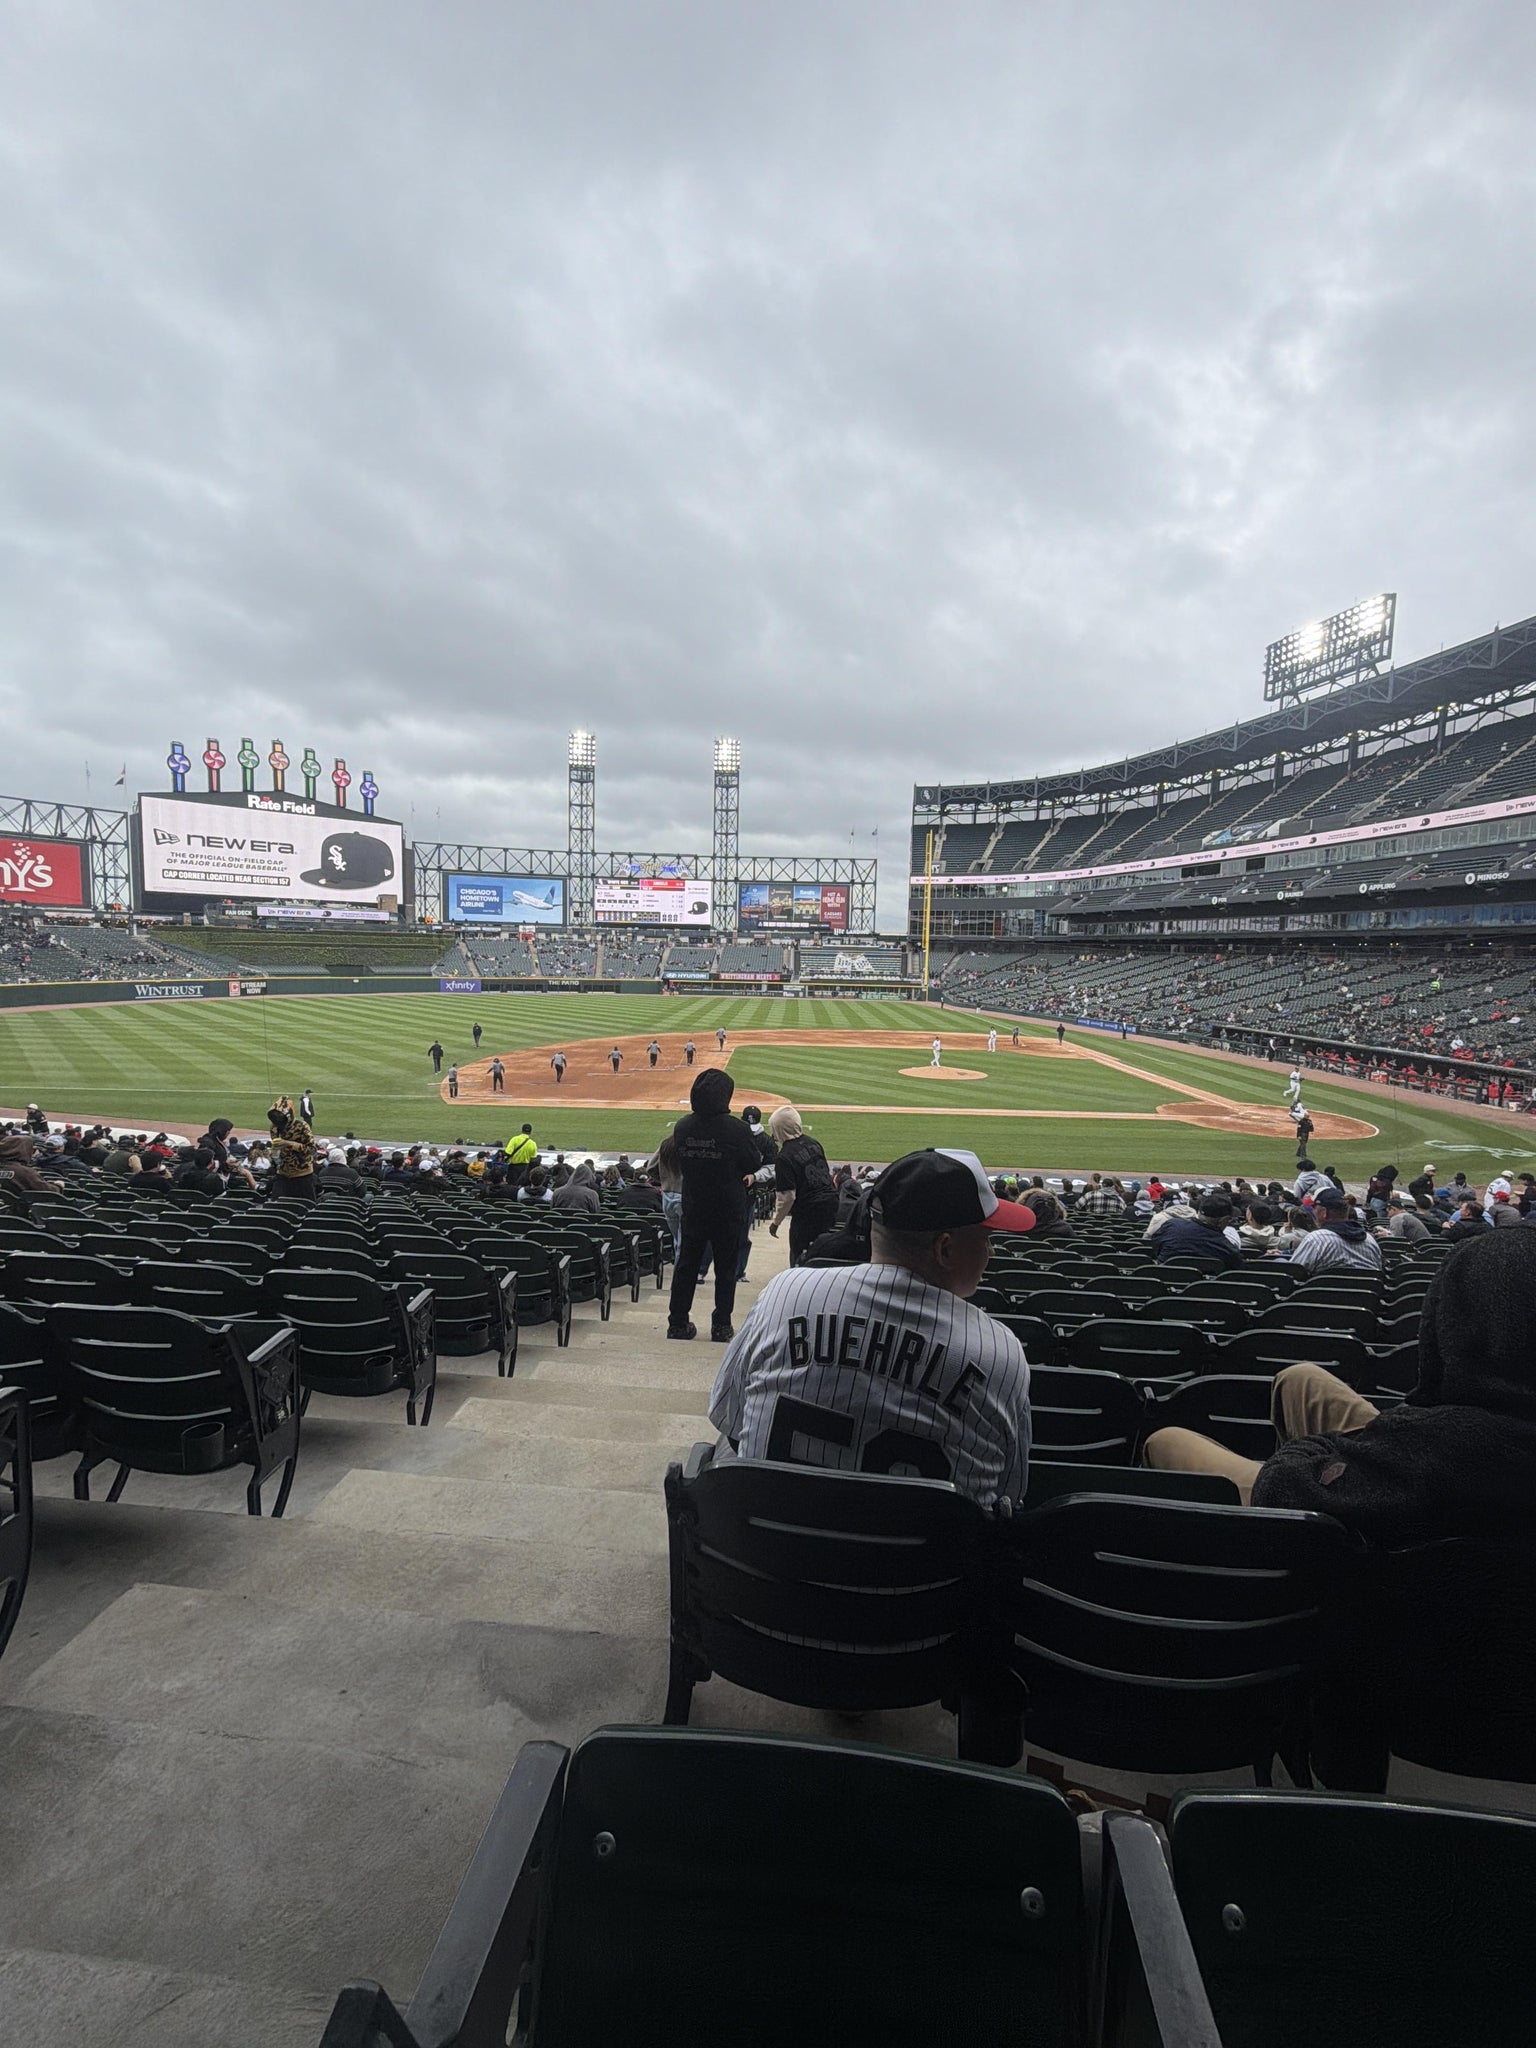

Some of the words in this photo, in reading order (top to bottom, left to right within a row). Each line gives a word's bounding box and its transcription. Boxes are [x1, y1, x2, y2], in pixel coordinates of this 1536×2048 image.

[248, 794, 281, 812] Rate
[283, 801, 316, 816] Field
[180, 859, 211, 867] MAJOR
[212, 861, 245, 869] LEAGUE
[188, 853, 226, 862] OFFICIAL
[228, 856, 265, 865] ON-FIELD
[163, 870, 177, 879] CAP
[178, 871, 206, 880] CORNER
[206, 873, 234, 882] LOCATED
[235, 875, 252, 883] NEAR
[253, 876, 279, 885] SECTION
[279, 878, 289, 886] 157
[1476, 872, 1510, 881] MINOSO
[460, 888, 497, 896] CHICAGO'S
[1368, 882, 1397, 891] APPLING
[135, 984, 204, 996] WINTRUST
[445, 980, 475, 992] xfinity
[685, 1136, 716, 1149] Guest
[787, 1312, 988, 1418] BUEHRLE
